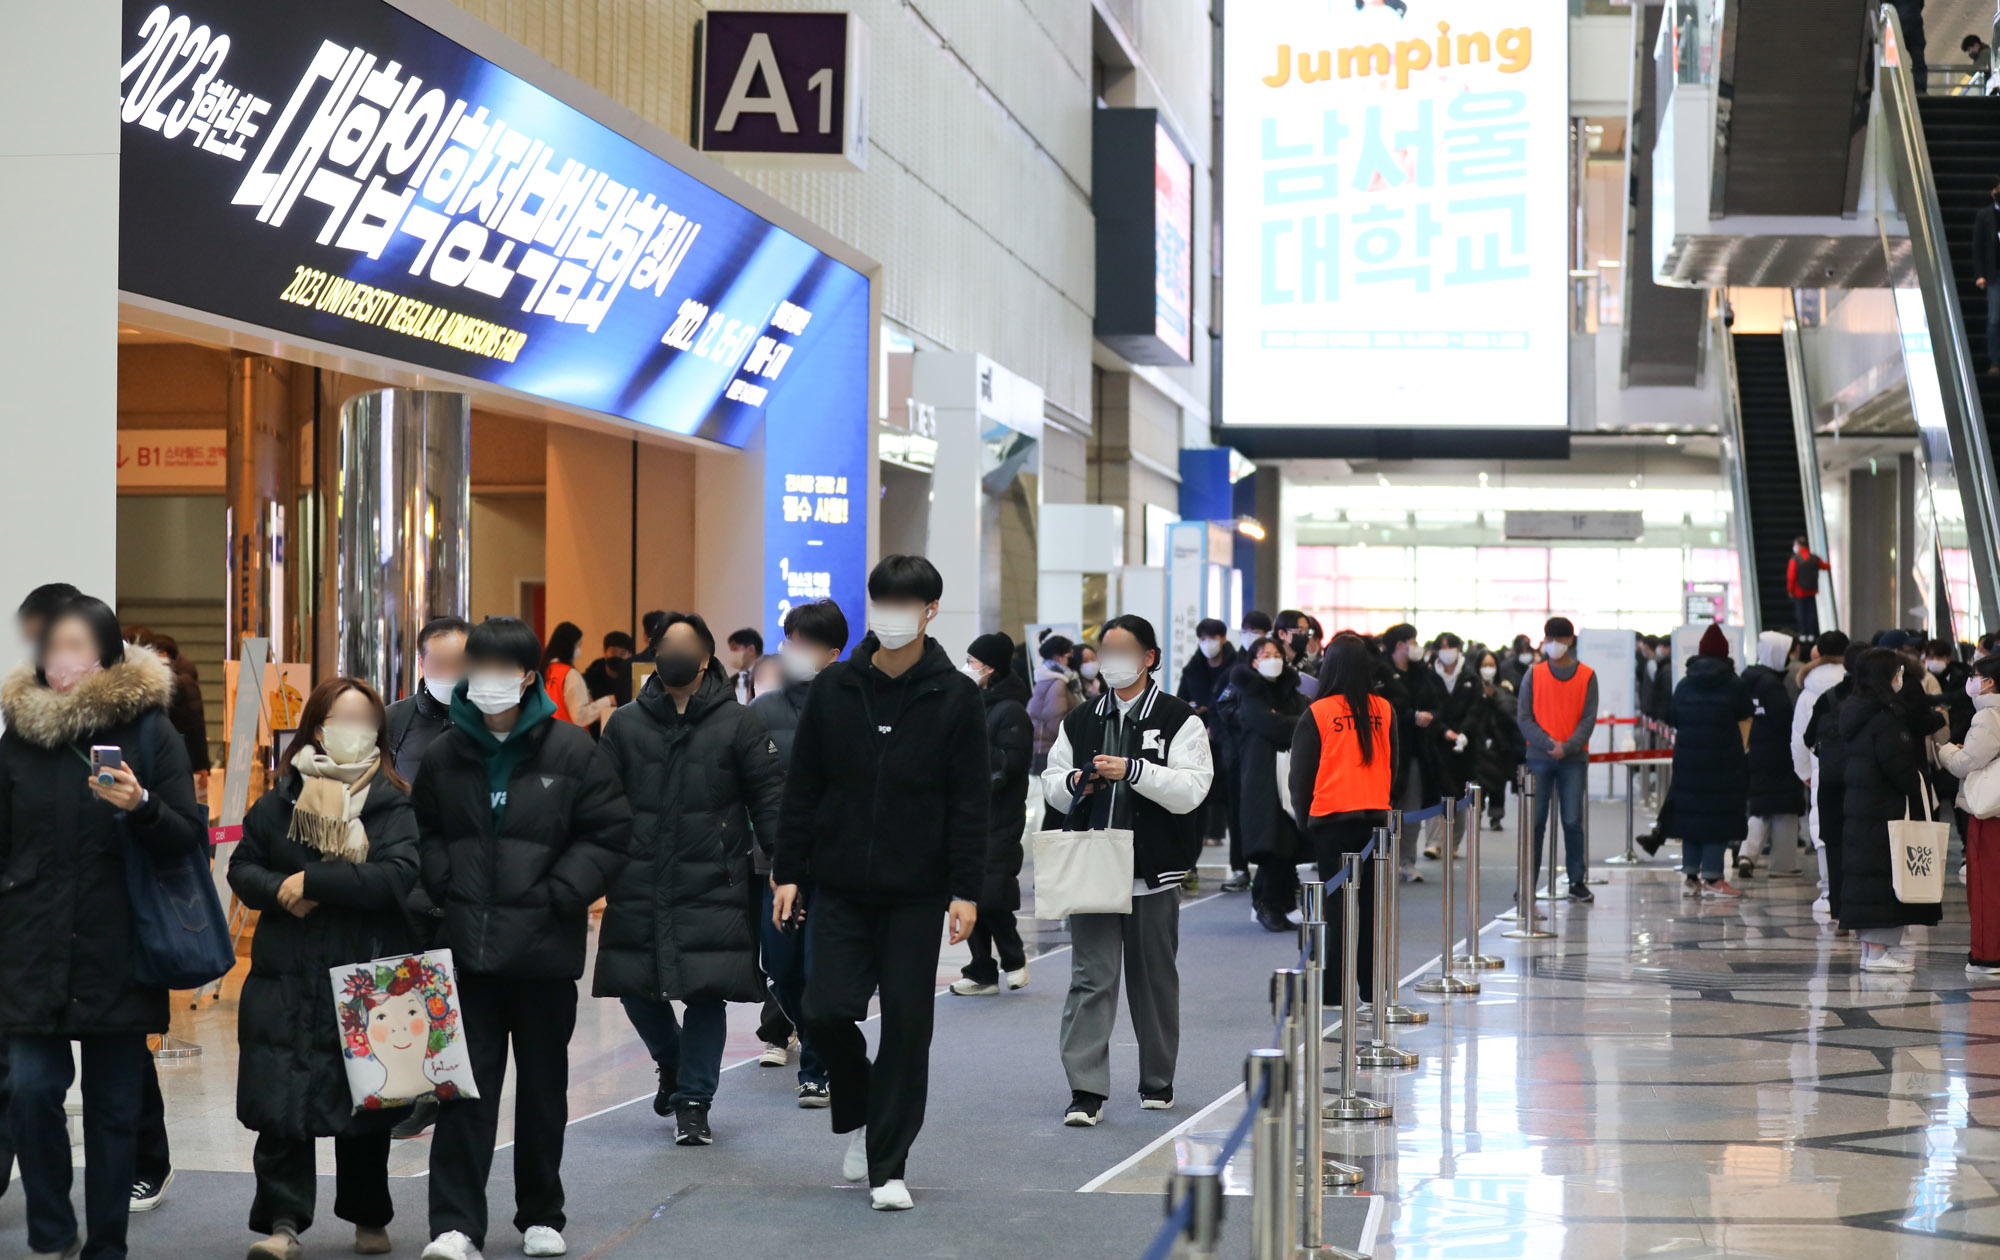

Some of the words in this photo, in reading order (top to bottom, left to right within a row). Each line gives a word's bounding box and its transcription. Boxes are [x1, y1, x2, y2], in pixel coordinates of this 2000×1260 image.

[714, 33, 833, 134] A1
[1261, 20, 1532, 90] Jumping
[1261, 90, 1531, 206] 남서울
[231, 39, 656, 333] 대학입학정보박람회
[1261, 193, 1531, 305] 대학교
[280, 265, 327, 307] 2023
[315, 275, 399, 326] UNIVERSITY
[385, 296, 447, 340] REGULAR
[438, 312, 507, 358] ADMISSIONS
[497, 328, 527, 363] FAIR
[138, 447, 160, 467] B1
[1571, 516, 1587, 529] 1F
[780, 557, 789, 581] 1
[778, 600, 791, 627] 2
[1333, 715, 1382, 732] STFF
